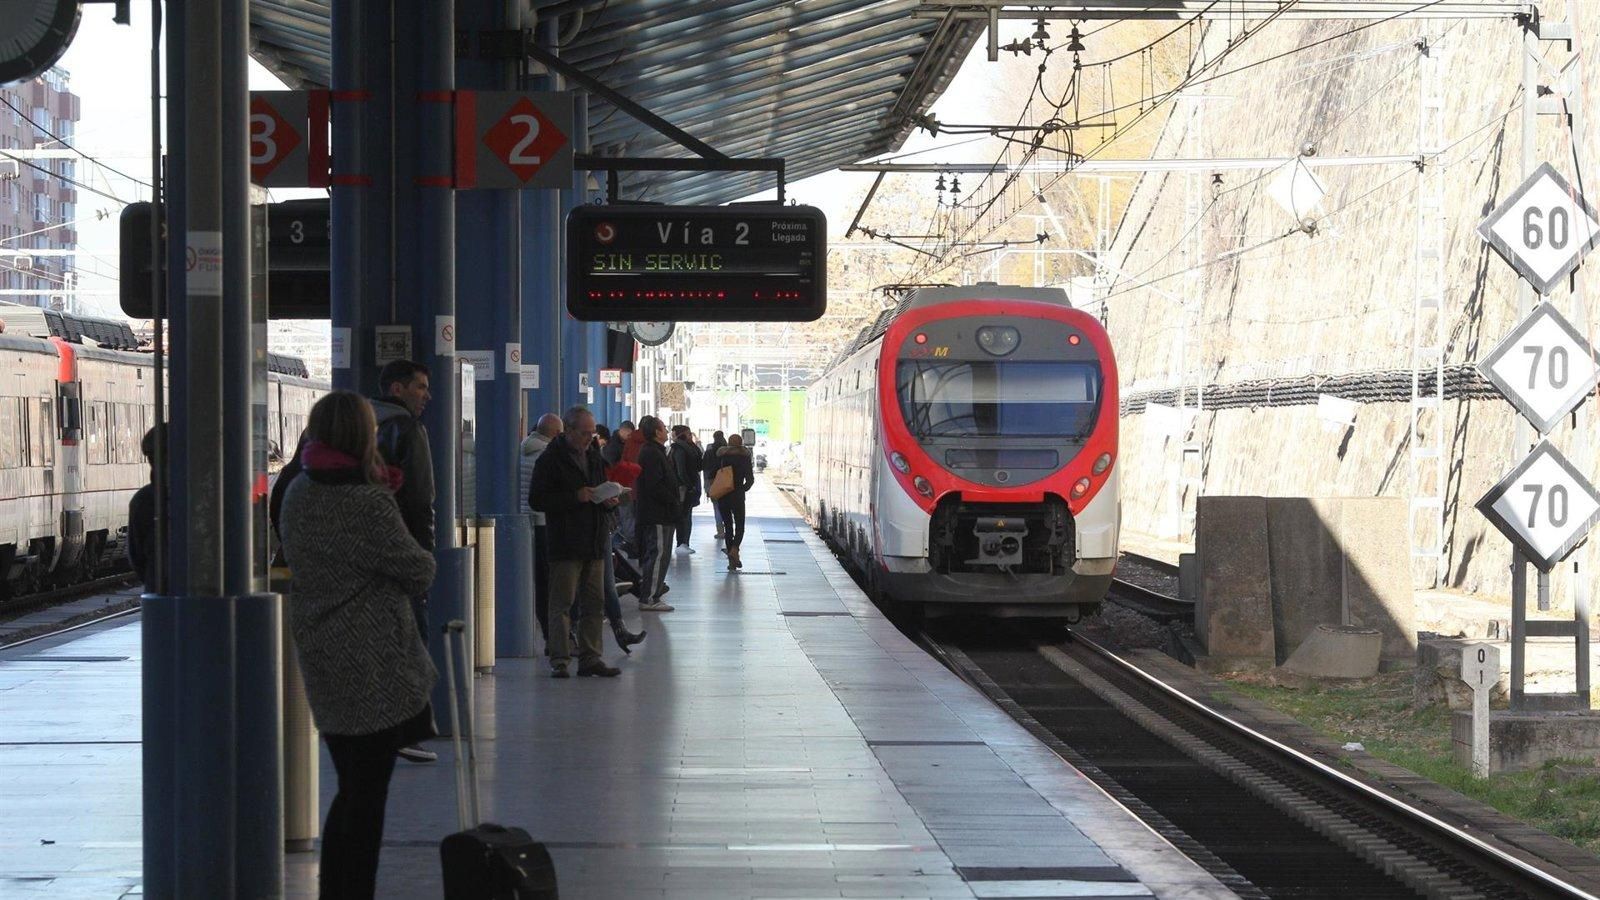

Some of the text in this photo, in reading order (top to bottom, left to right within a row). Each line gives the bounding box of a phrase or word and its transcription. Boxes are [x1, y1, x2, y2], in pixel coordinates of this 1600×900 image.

[250, 114, 277, 165] 3
[508, 114, 541, 165] 2
[290, 220, 305, 244] 3
[657, 221, 750, 245] Vía 2
[771, 221, 808, 231] Próxima
[772, 232, 806, 244] Llegada
[1522, 206, 1569, 250] 60
[593, 254, 723, 271] SIN SERVIC
[1522, 345, 1569, 390] 70
[1522, 484, 1569, 529] 70
[1477, 648, 1486, 664] 0
[1479, 670, 1484, 685] 1
